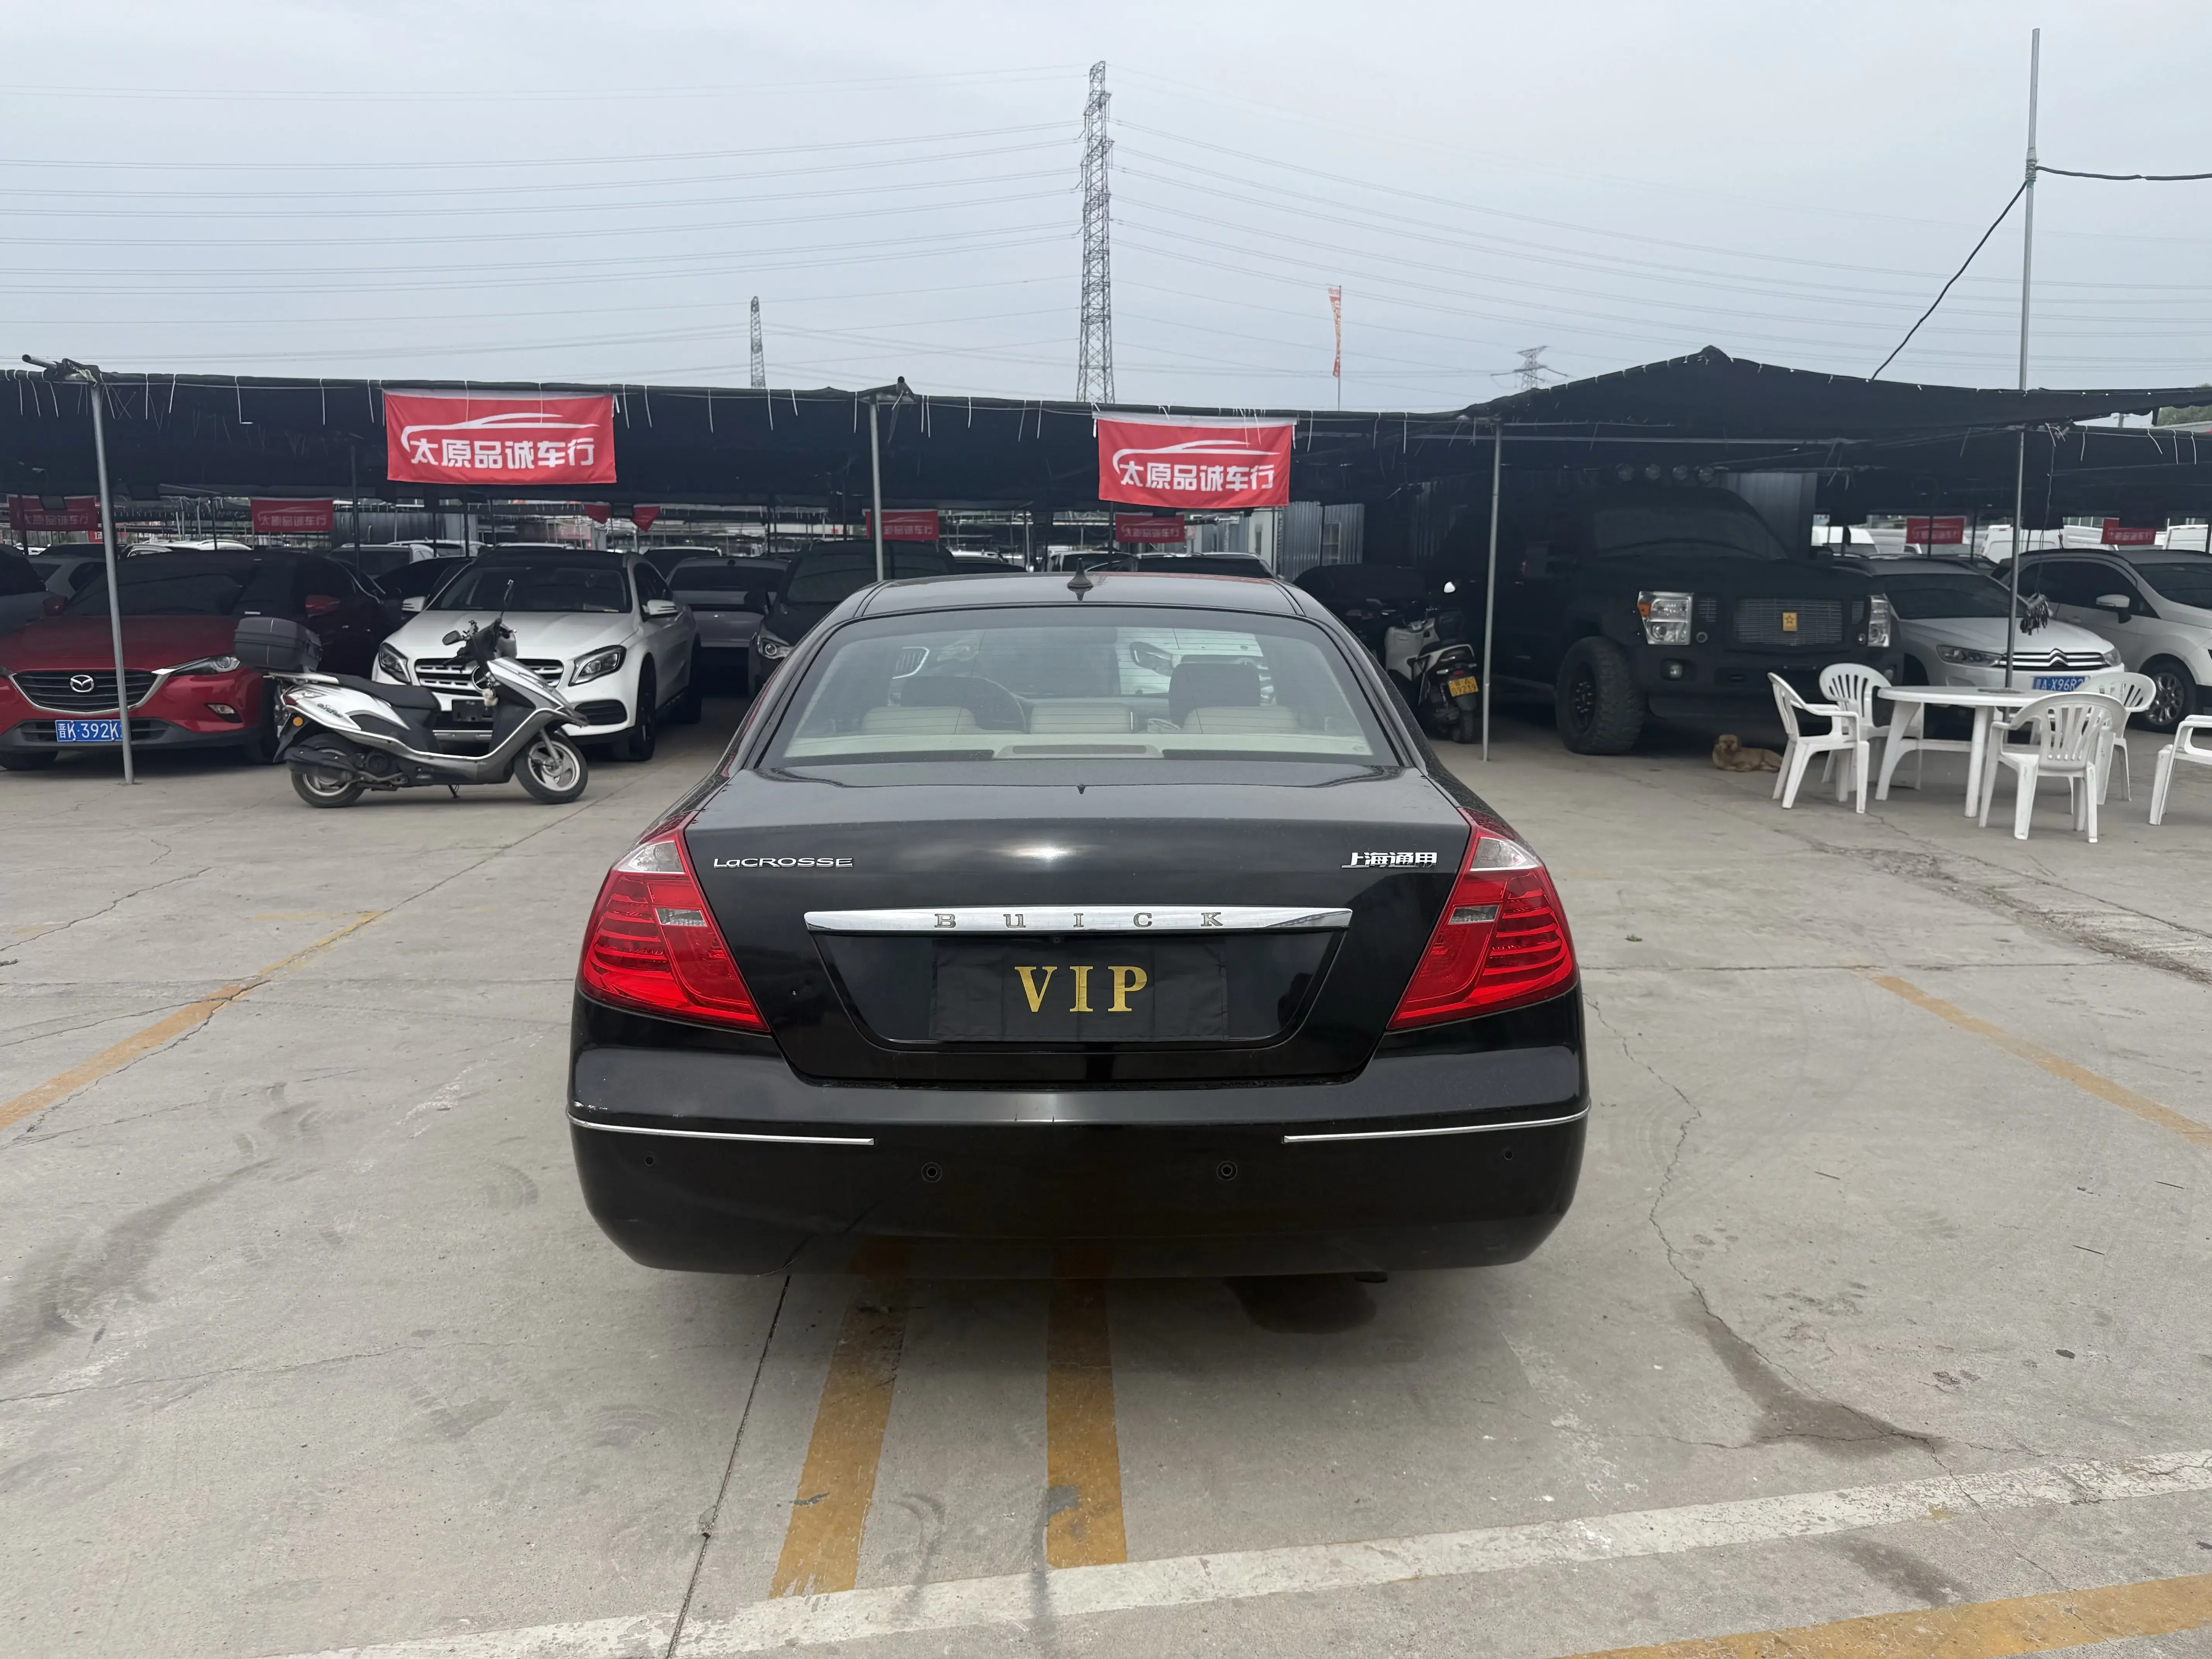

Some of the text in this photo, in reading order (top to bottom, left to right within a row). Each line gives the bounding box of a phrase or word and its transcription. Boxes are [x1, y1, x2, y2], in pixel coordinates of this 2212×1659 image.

[410, 438, 595, 469] 太原品诚车行
[1120, 460, 1274, 491] 太原品诚车行
[58, 723, 122, 738] 晋K·392K
[713, 857, 853, 868] LaCROSSE
[1341, 852, 1437, 868] 上海通用
[934, 912, 1223, 928] BUICK
[1015, 966, 1147, 1012] VIP
